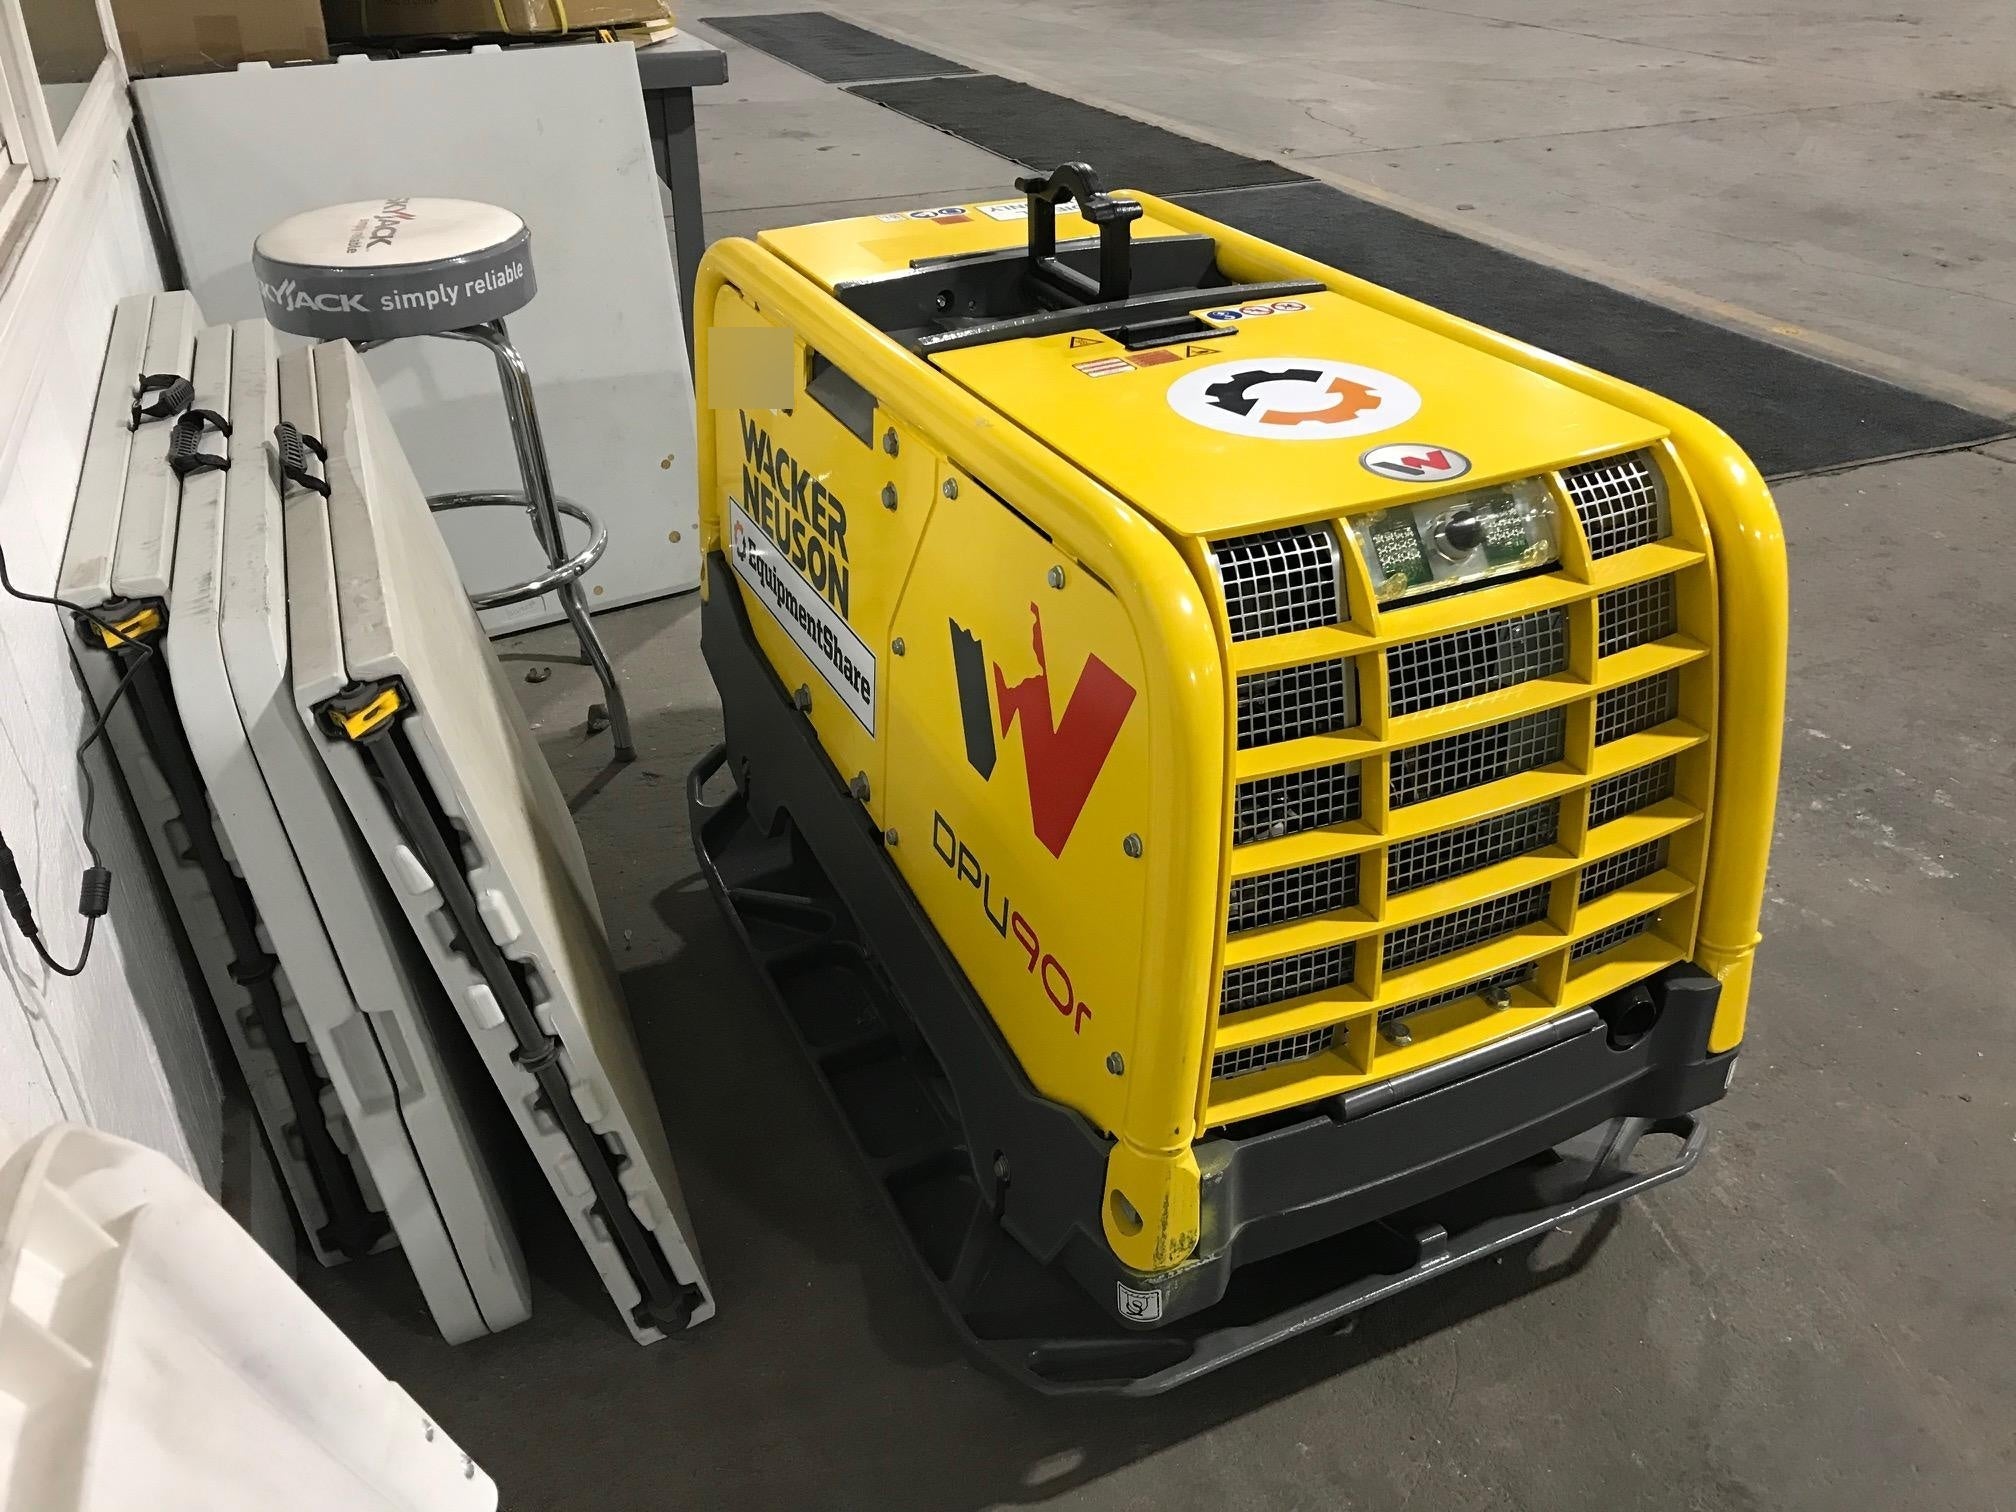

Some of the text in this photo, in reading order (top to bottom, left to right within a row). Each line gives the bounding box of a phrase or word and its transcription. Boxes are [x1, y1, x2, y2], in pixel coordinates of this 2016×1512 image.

[380, 283, 459, 310] simply
[465, 261, 524, 297] reliable
[739, 408, 849, 563] WACKER
[742, 462, 849, 621] NEUSON
[747, 536, 871, 705] EquipmentShare
